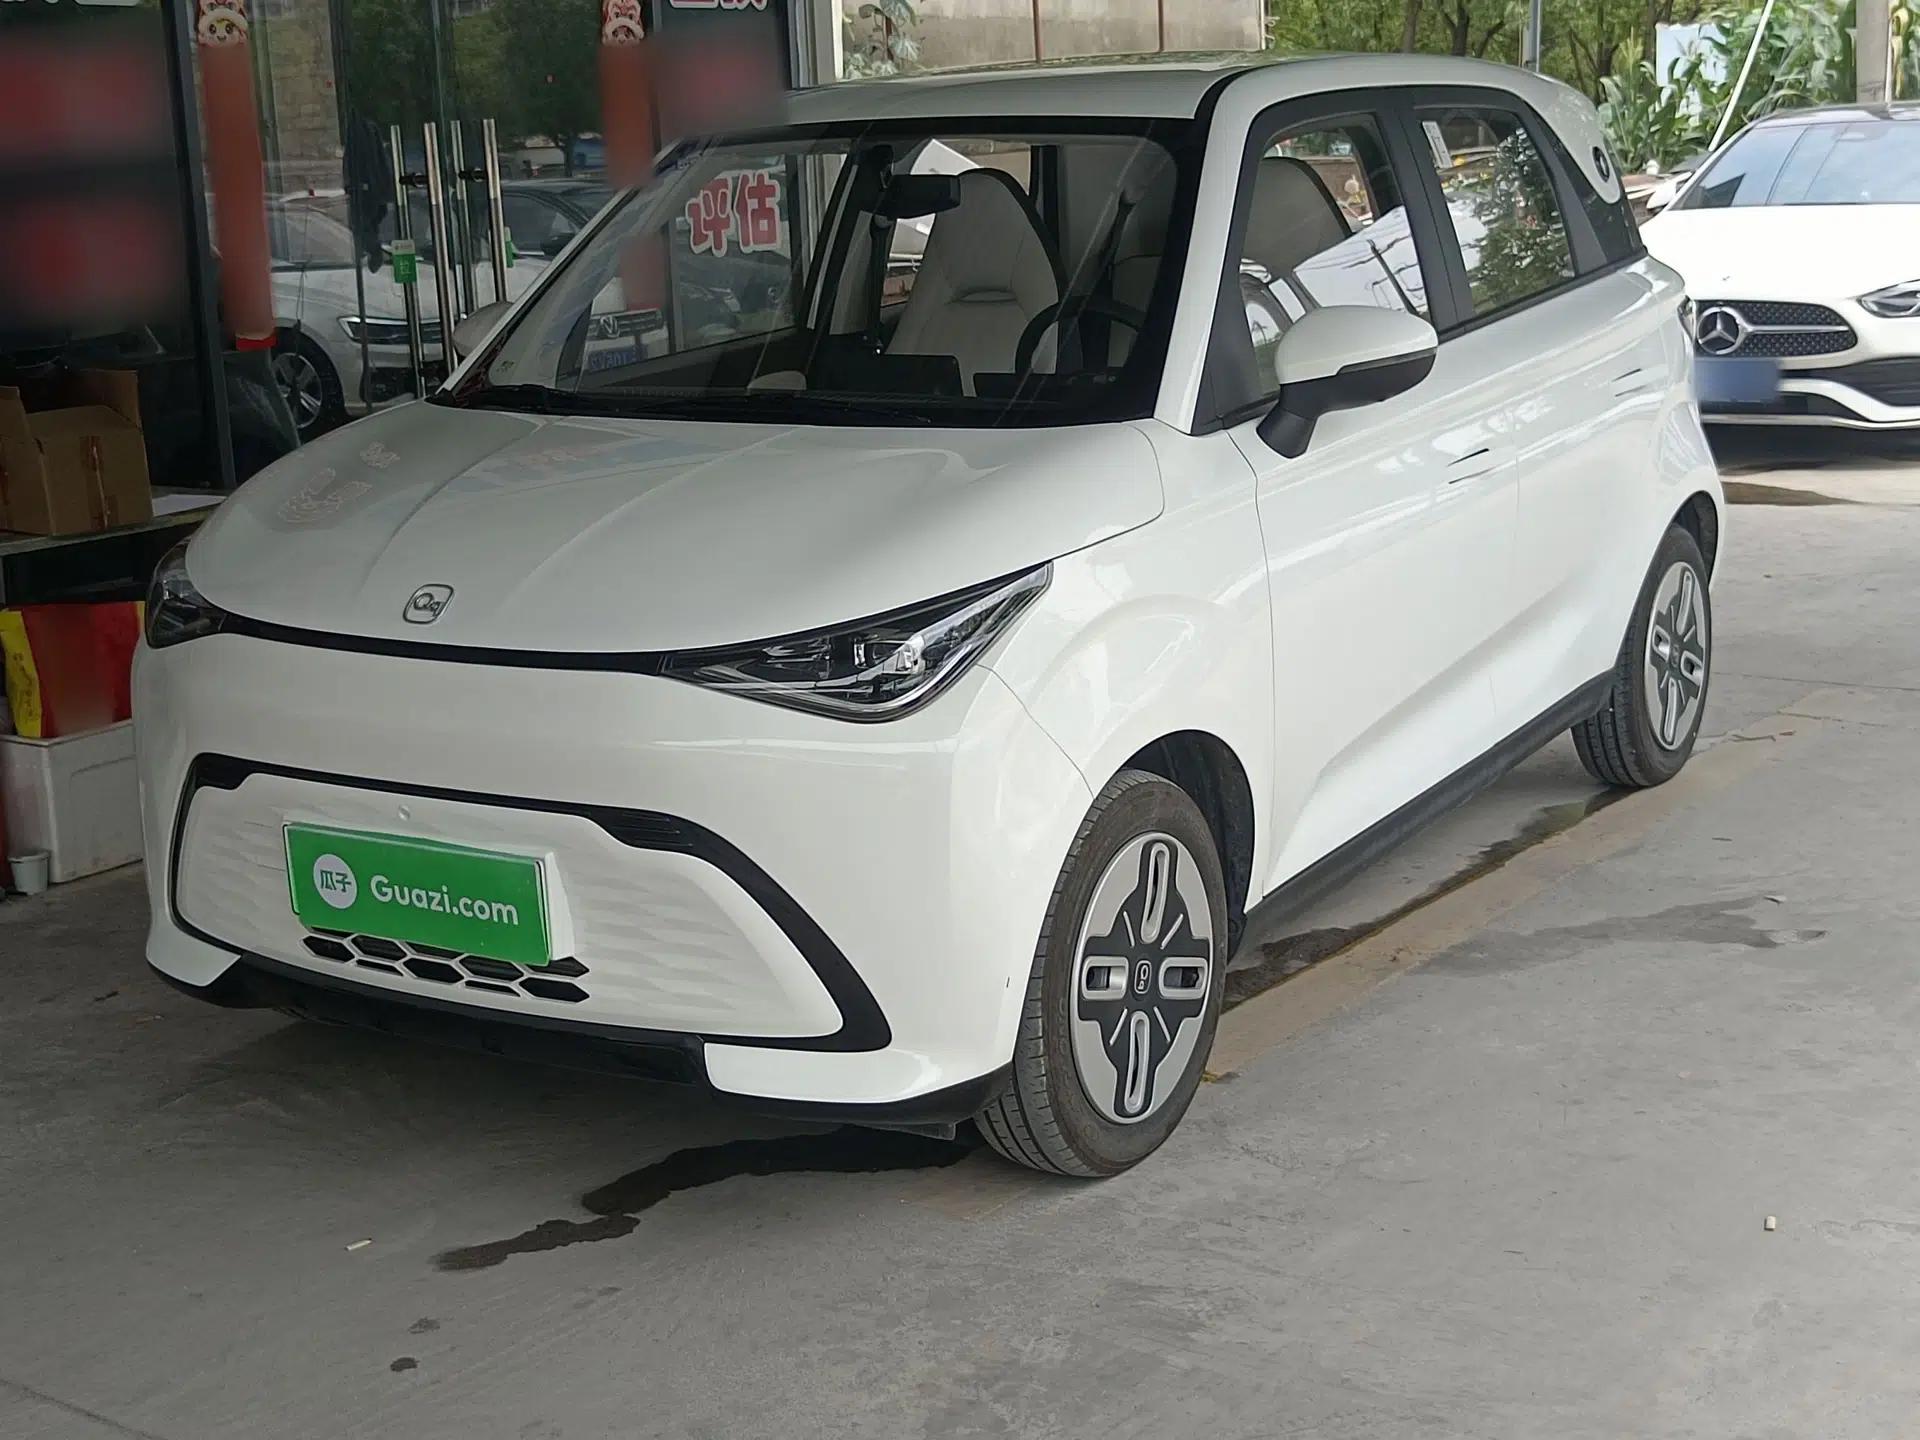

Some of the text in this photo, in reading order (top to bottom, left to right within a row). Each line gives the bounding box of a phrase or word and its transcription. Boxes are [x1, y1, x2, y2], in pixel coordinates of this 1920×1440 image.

[686, 170, 779, 256] 评估
[320, 869, 352, 893] 瓜子
[370, 874, 519, 926] Guazi.com
